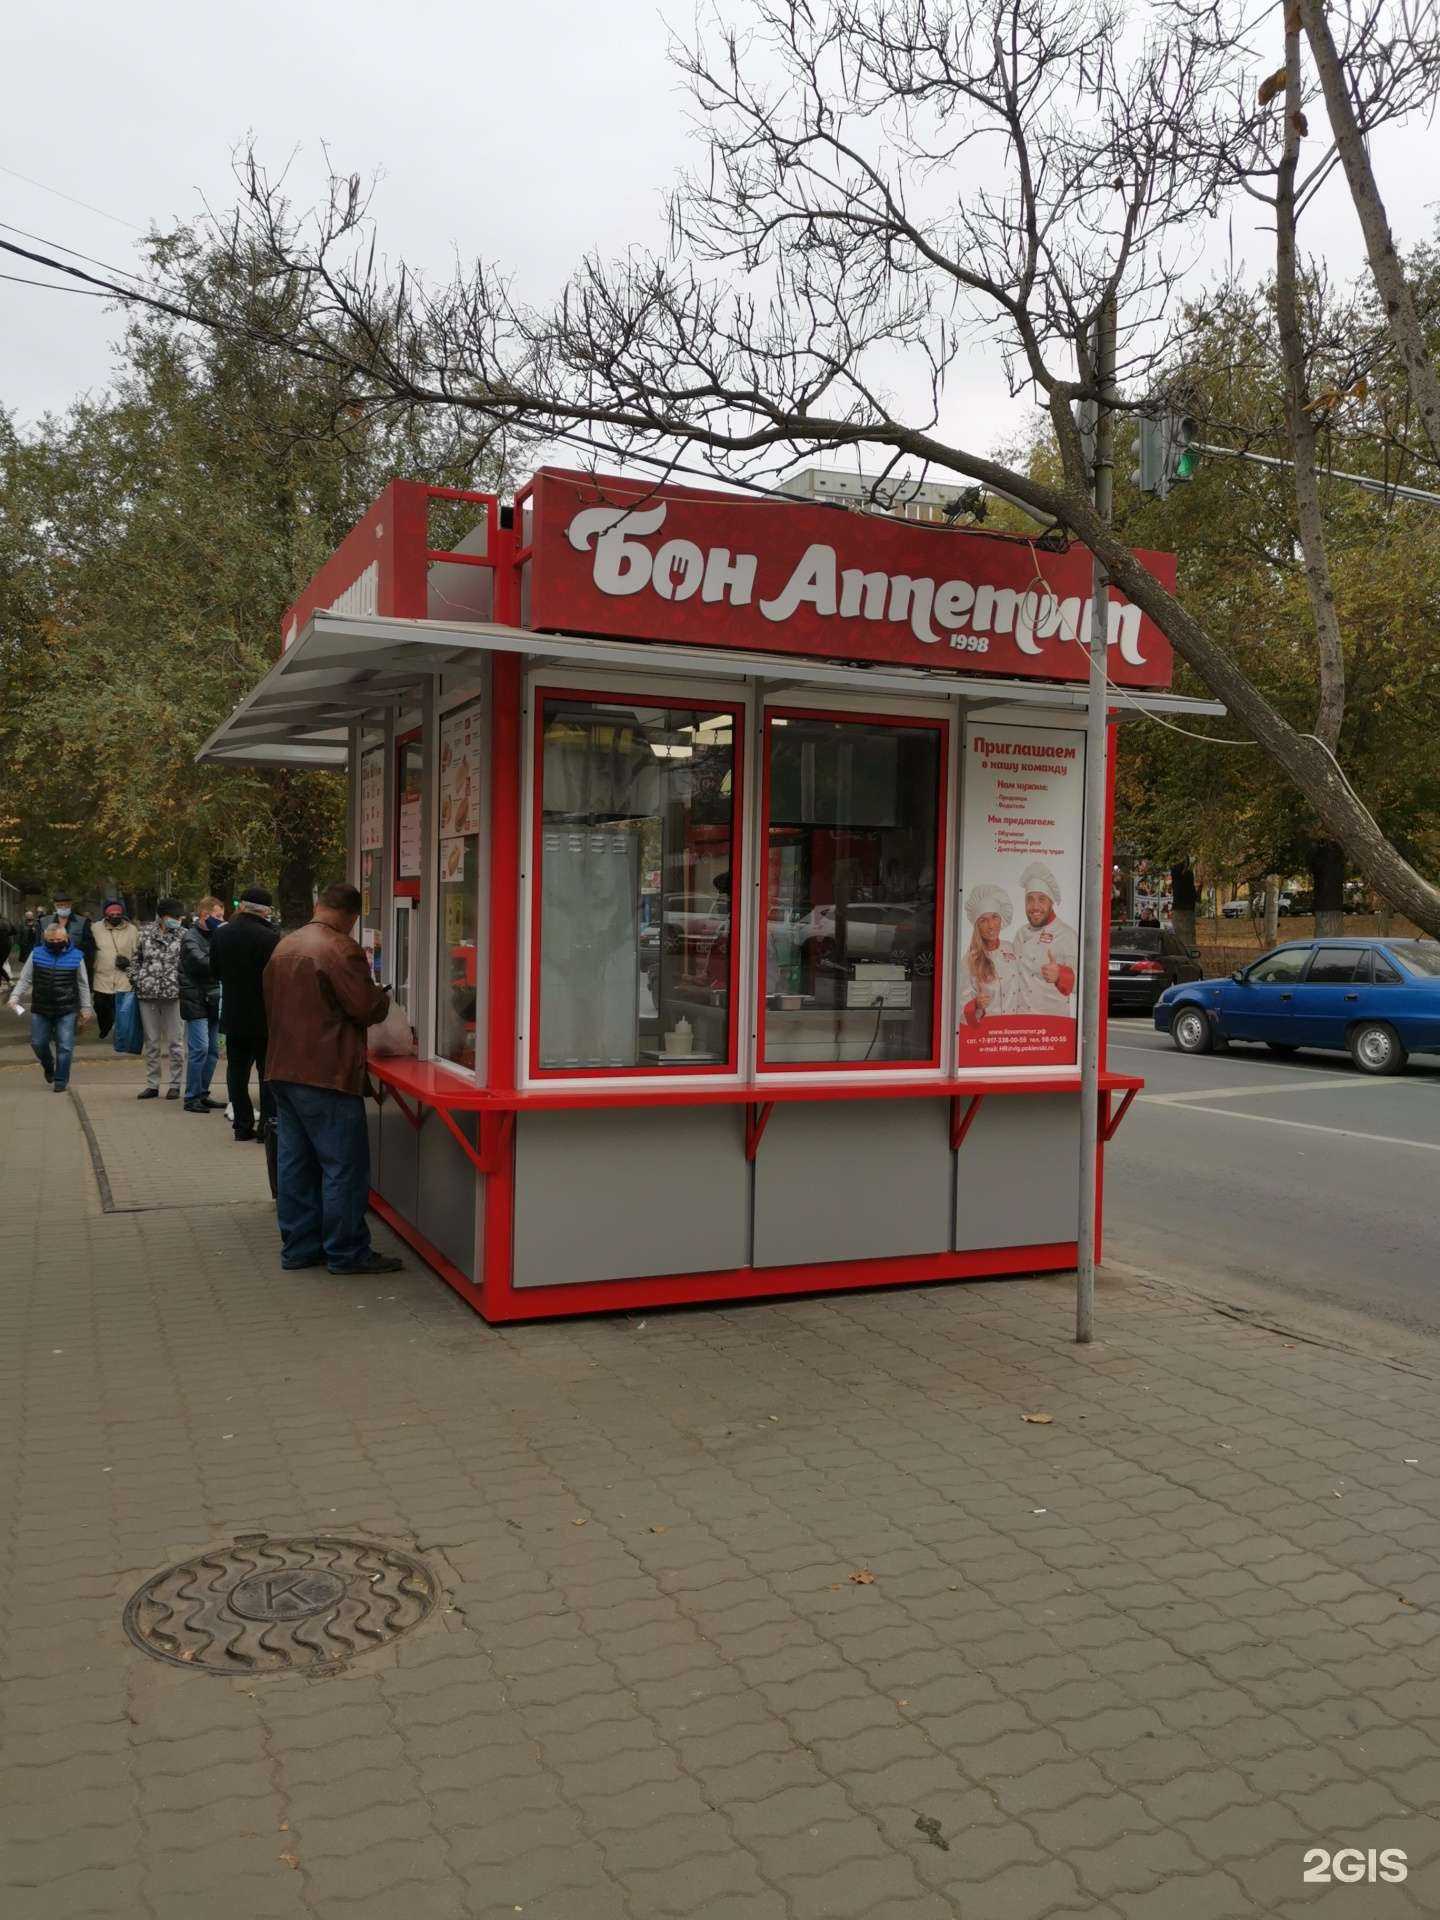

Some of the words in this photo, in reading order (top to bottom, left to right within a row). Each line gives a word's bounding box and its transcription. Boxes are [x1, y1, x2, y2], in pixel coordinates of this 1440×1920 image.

[567, 500, 758, 607] Бон
[949, 633, 989, 653] 1998
[974, 737, 1076, 759] Приглашаем
[982, 760, 988, 769] в
[990, 761, 1019, 773] нашу
[1021, 763, 1068, 775] команду
